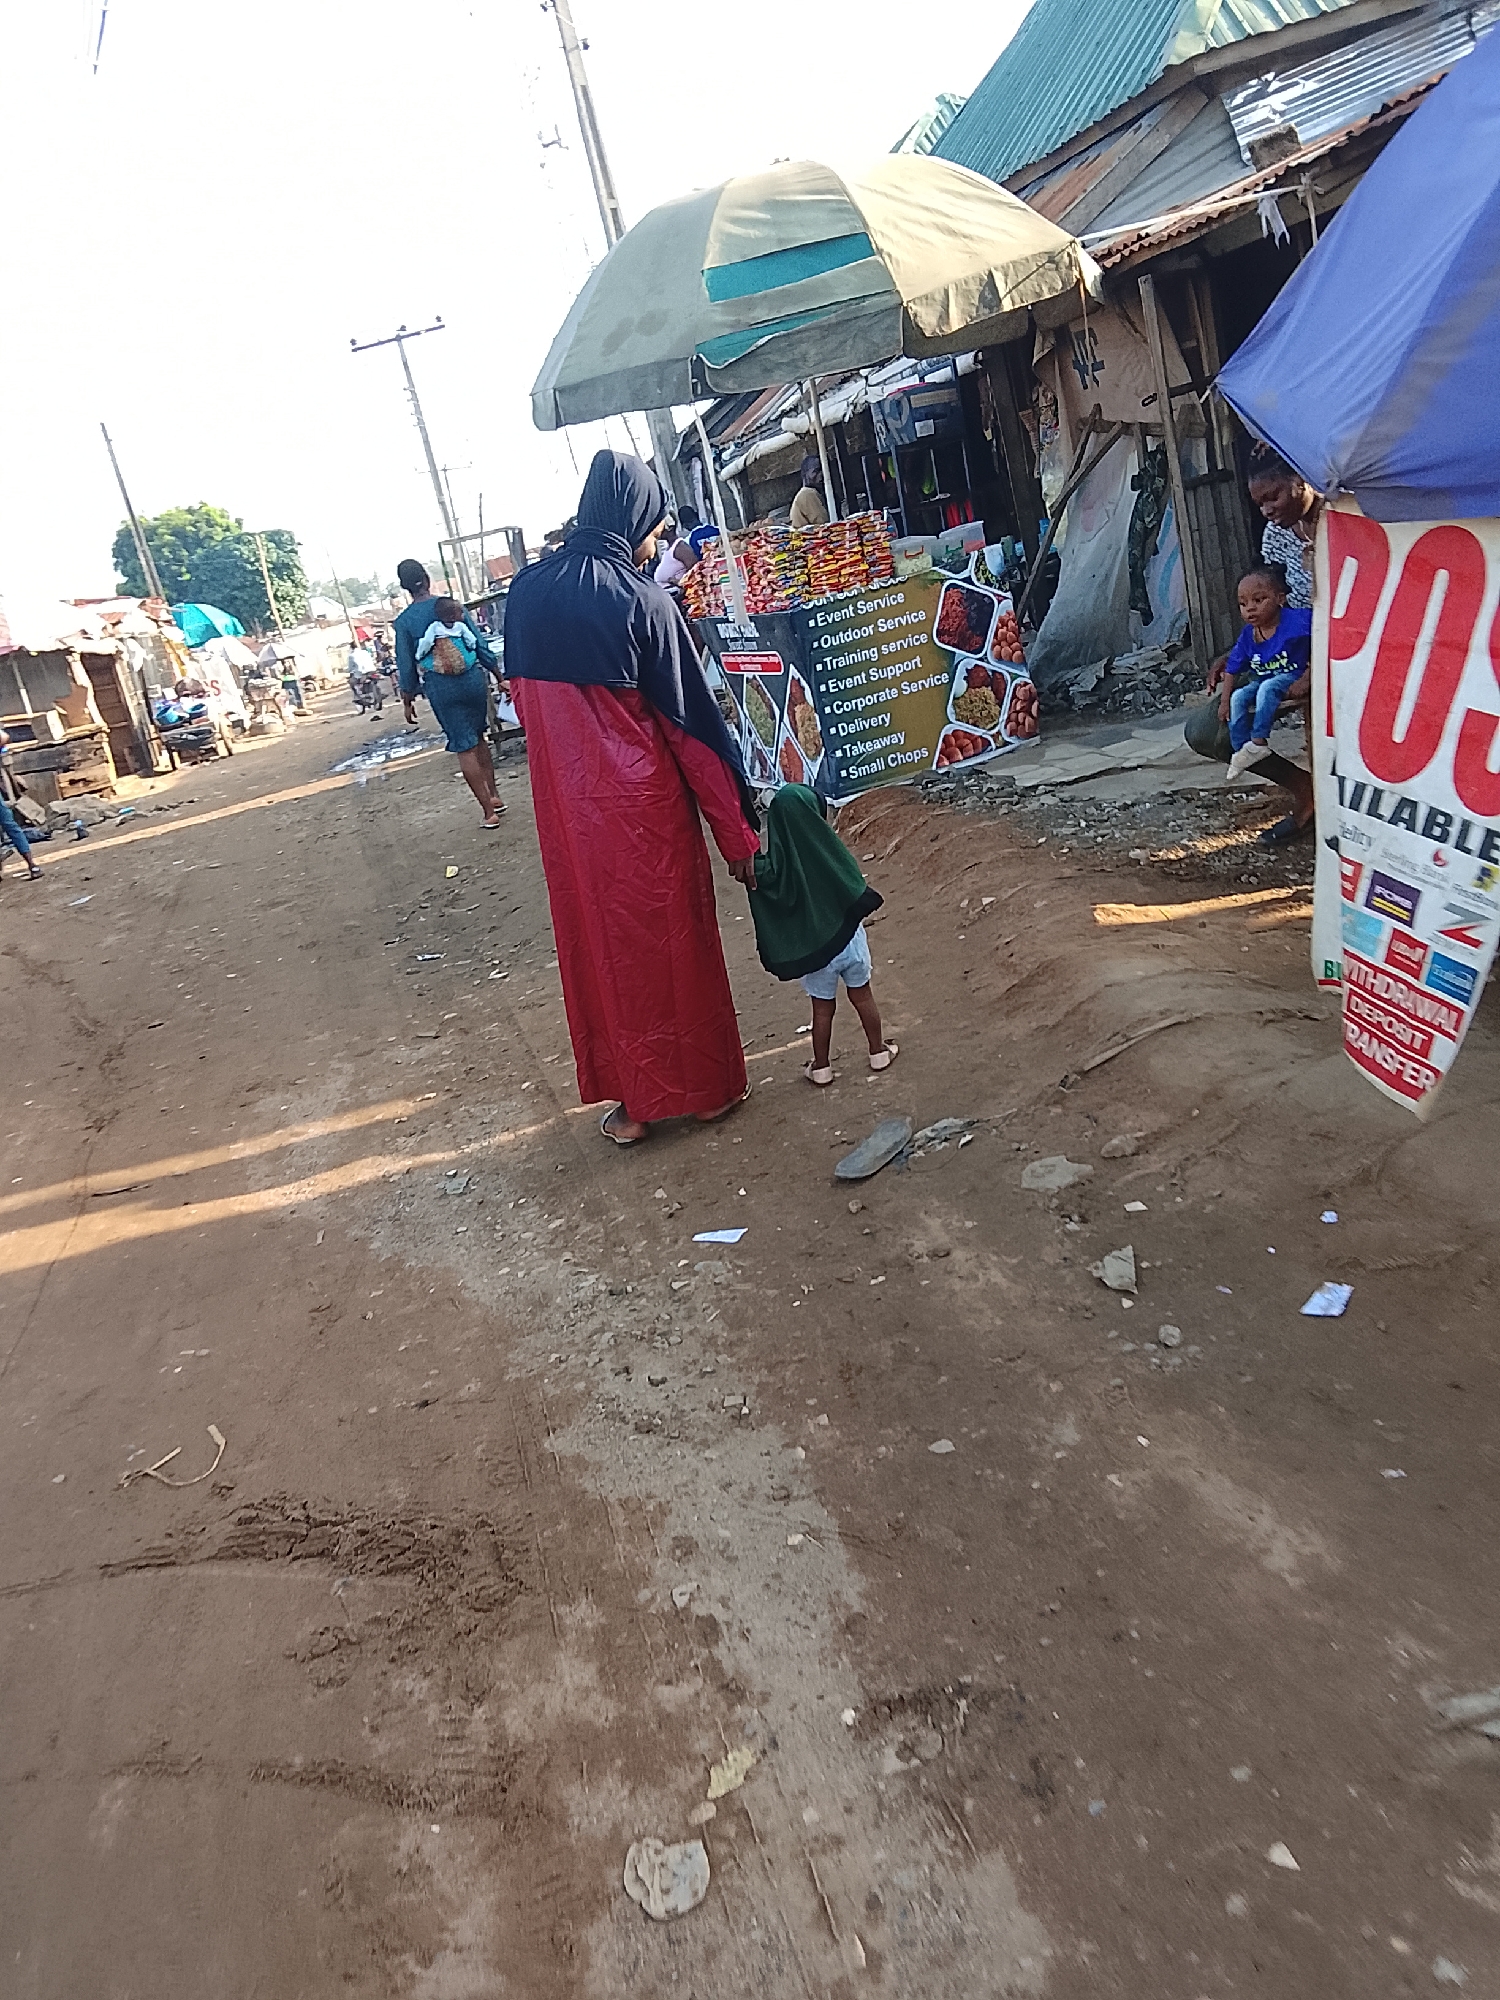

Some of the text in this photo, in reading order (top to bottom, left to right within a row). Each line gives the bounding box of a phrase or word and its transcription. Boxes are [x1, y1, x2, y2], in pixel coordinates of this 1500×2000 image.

[816, 604, 855, 627] Event
[856, 592, 905, 614] Service
[820, 609, 927, 649] Outdoor Service
[823, 633, 929, 671] Training service
[827, 655, 923, 693] Event Support
[832, 672, 950, 715] Corporate Service
[837, 712, 891, 738] Delivery
[842, 731, 906, 758] Takeaway
[848, 747, 929, 780] Small Chops
[1350, 994, 1429, 1050] DEPOSIT
[1343, 1019, 1436, 1091] RANSFER
